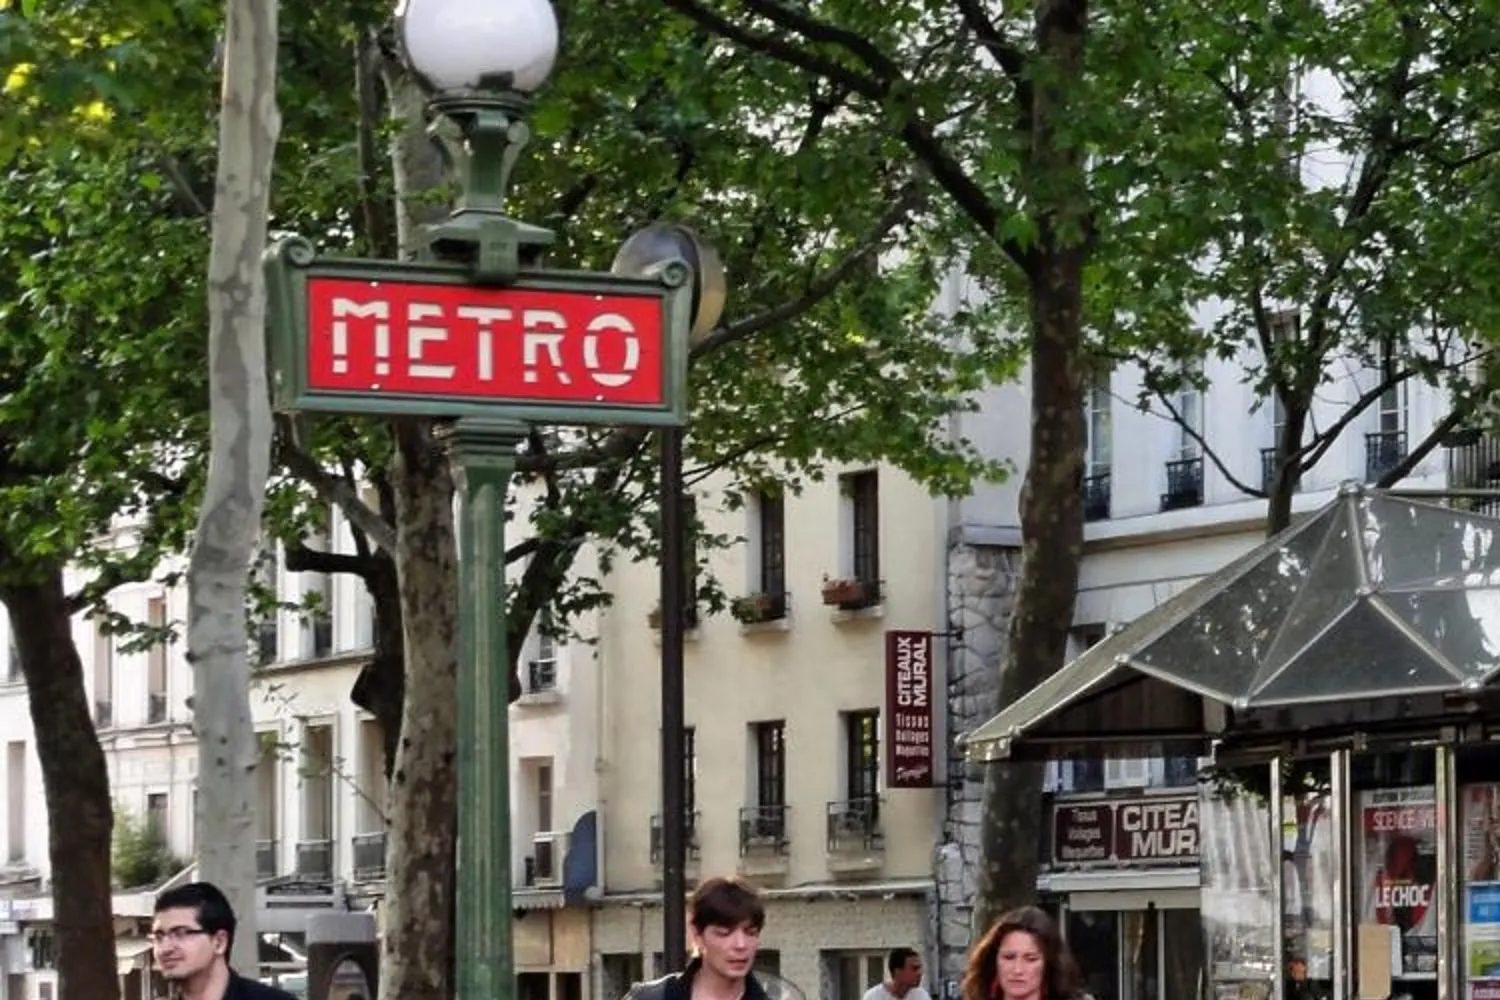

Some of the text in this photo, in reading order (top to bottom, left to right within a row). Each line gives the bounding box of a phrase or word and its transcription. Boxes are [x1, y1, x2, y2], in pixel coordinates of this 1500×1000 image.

[331, 297, 640, 387] METRO
[897, 637, 912, 706] CITEAUX
[913, 638, 928, 707] MURAL
[1122, 804, 1199, 831] CITEA
[1131, 830, 1199, 857] MUR
[1376, 884, 1430, 908] LE CHOC
